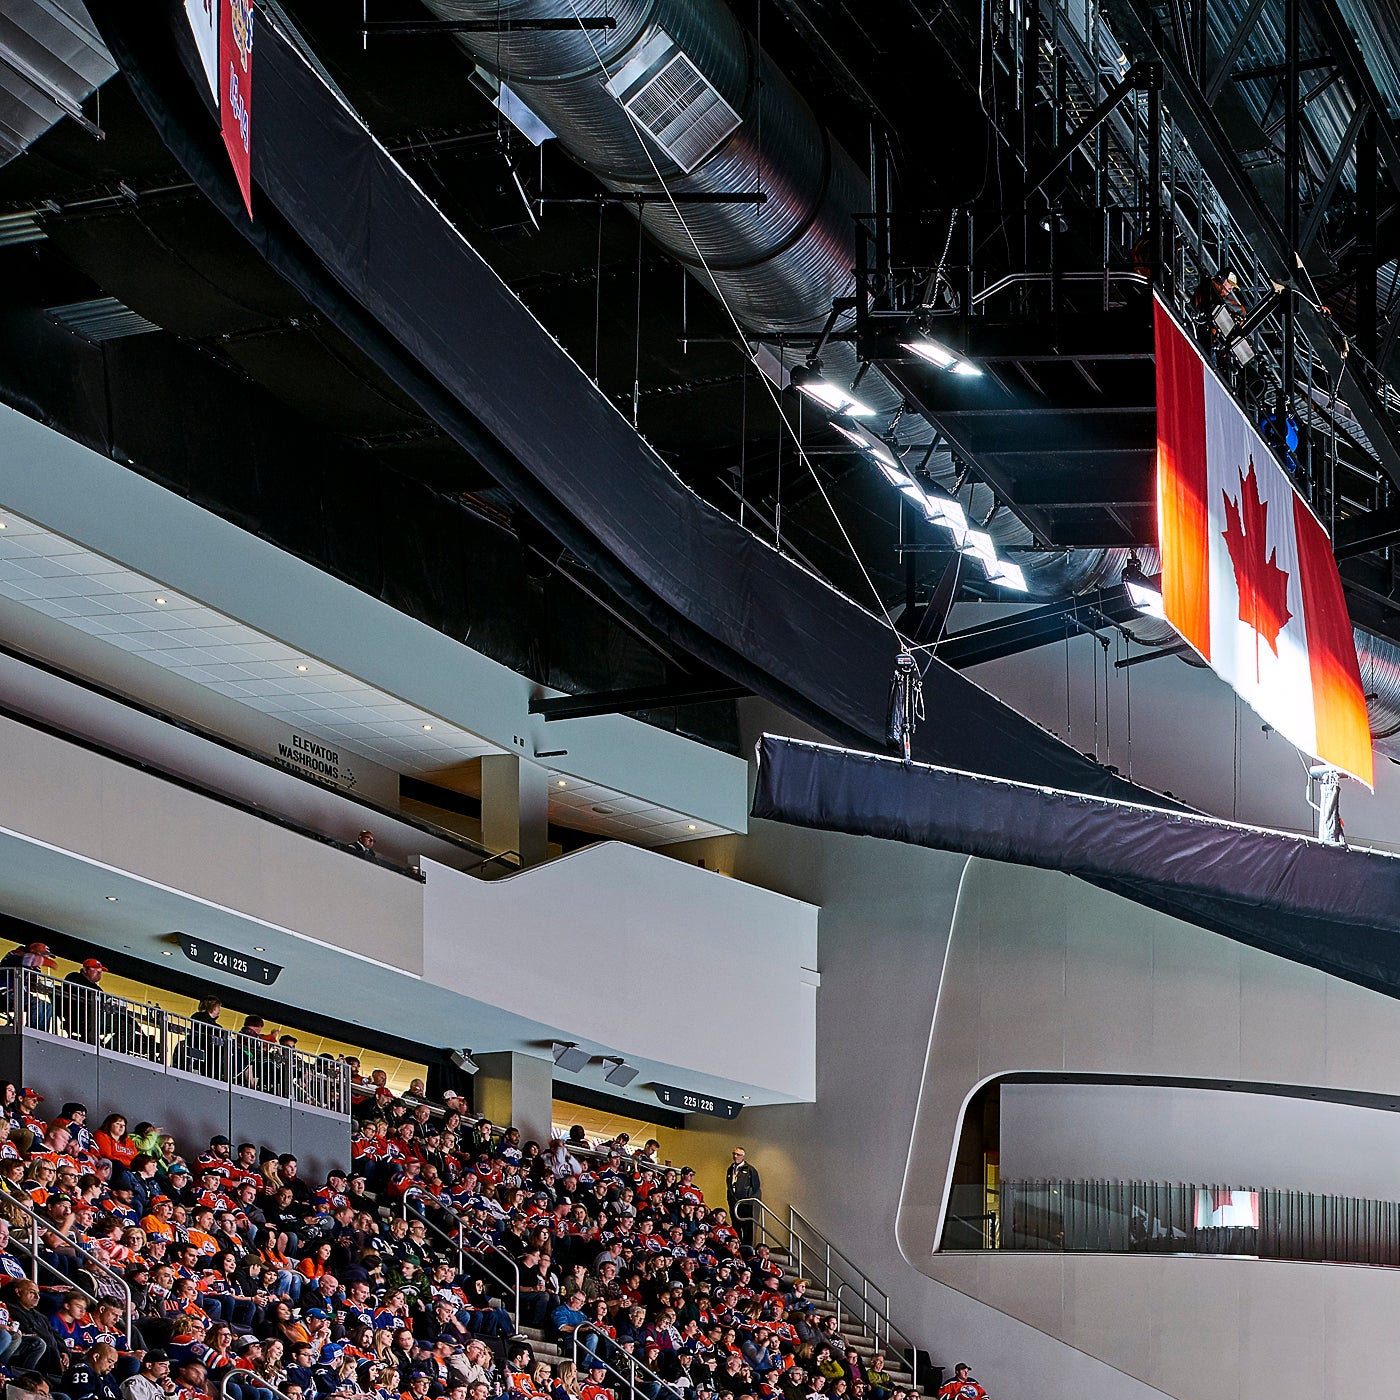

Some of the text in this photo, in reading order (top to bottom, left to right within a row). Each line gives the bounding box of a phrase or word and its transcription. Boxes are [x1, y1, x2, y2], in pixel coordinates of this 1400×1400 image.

[278, 742, 339, 779] WASHROOMS
[292, 734, 339, 765] ELEVATOR
[213, 951, 248, 973] 224 225
[683, 1095, 714, 1112] 225 226
[72, 1372, 89, 1384] 33
